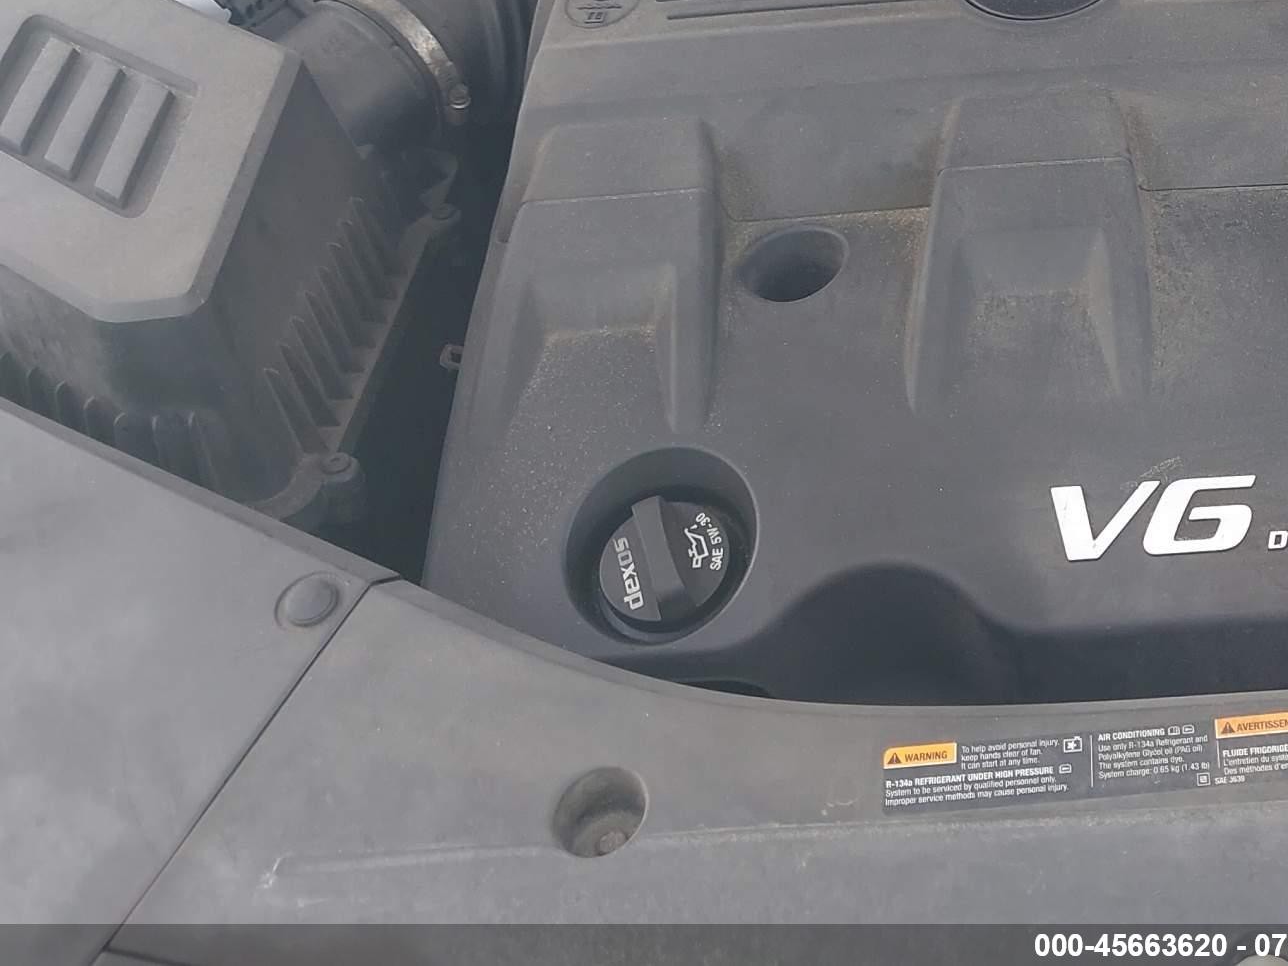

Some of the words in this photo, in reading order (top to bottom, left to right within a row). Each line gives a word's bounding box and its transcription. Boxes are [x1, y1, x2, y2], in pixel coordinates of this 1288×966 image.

[1050, 475, 1256, 561] V6
[695, 512, 722, 546] 5W-30
[710, 548, 724, 571] SAE
[612, 537, 644, 610] dexos
[1098, 733, 1110, 741] AIR
[1112, 728, 1165, 740] CONDITIONING
[961, 745, 970, 754] To
[971, 745, 986, 754] help
[988, 742, 1006, 751] avoid
[1008, 739, 1037, 751] personal
[1040, 738, 1060, 748] injury.
[1098, 744, 1111, 752] Use
[1113, 742, 1127, 752] only
[1195, 734, 1208, 743] and
[905, 751, 948, 762] WARNING
[961, 753, 978, 762] keep
[980, 751, 1001, 760] hands
[1003, 749, 1019, 758] clear
[1021, 748, 1029, 756] of
[1098, 750, 1140, 761] Polyalkylene
[1142, 748, 1163, 758] Glycol
[1165, 747, 1173, 755] oil
[1175, 746, 1191, 755] (PAG
[1192, 744, 1203, 753] oil)
[1223, 749, 1248, 758] FLUIDE
[1260, 755, 1270, 763] du
[982, 759, 998, 768] start
[1000, 759, 1006, 767] at
[1008, 758, 1021, 766] any
[1099, 770, 1125, 779] System
[1126, 767, 1152, 777] charge:
[1171, 764, 1180, 774] kg
[1201, 761, 1210, 771] lb)
[1100, 762, 1111, 770] The
[1113, 760, 1138, 769] system
[1140, 757, 1168, 766] contains
[1223, 767, 1238, 775] Des
[886, 779, 913, 789] R-134a
[915, 774, 965, 786] REFRIGERANT
[968, 772, 993, 782] UNDER
[995, 770, 1013, 779] HIGH
[1015, 766, 1053, 777] PRESSURE
[1215, 777, 1227, 785] SAE
[885, 788, 911, 798] System
[922, 786, 930, 794] be
[932, 783, 961, 792] serviced
[963, 782, 972, 792] by
[974, 779, 1003, 791] qualified
[1005, 777, 1039, 788] personnel
[1041, 775, 1056, 784] only.
[885, 797, 916, 807] Improper
[918, 794, 943, 803] service
[945, 791, 975, 801] methods
[977, 790, 992, 798] may
[994, 788, 1014, 796] cause
[1016, 784, 1046, 795] personal
[1048, 783, 1069, 792] injury.
